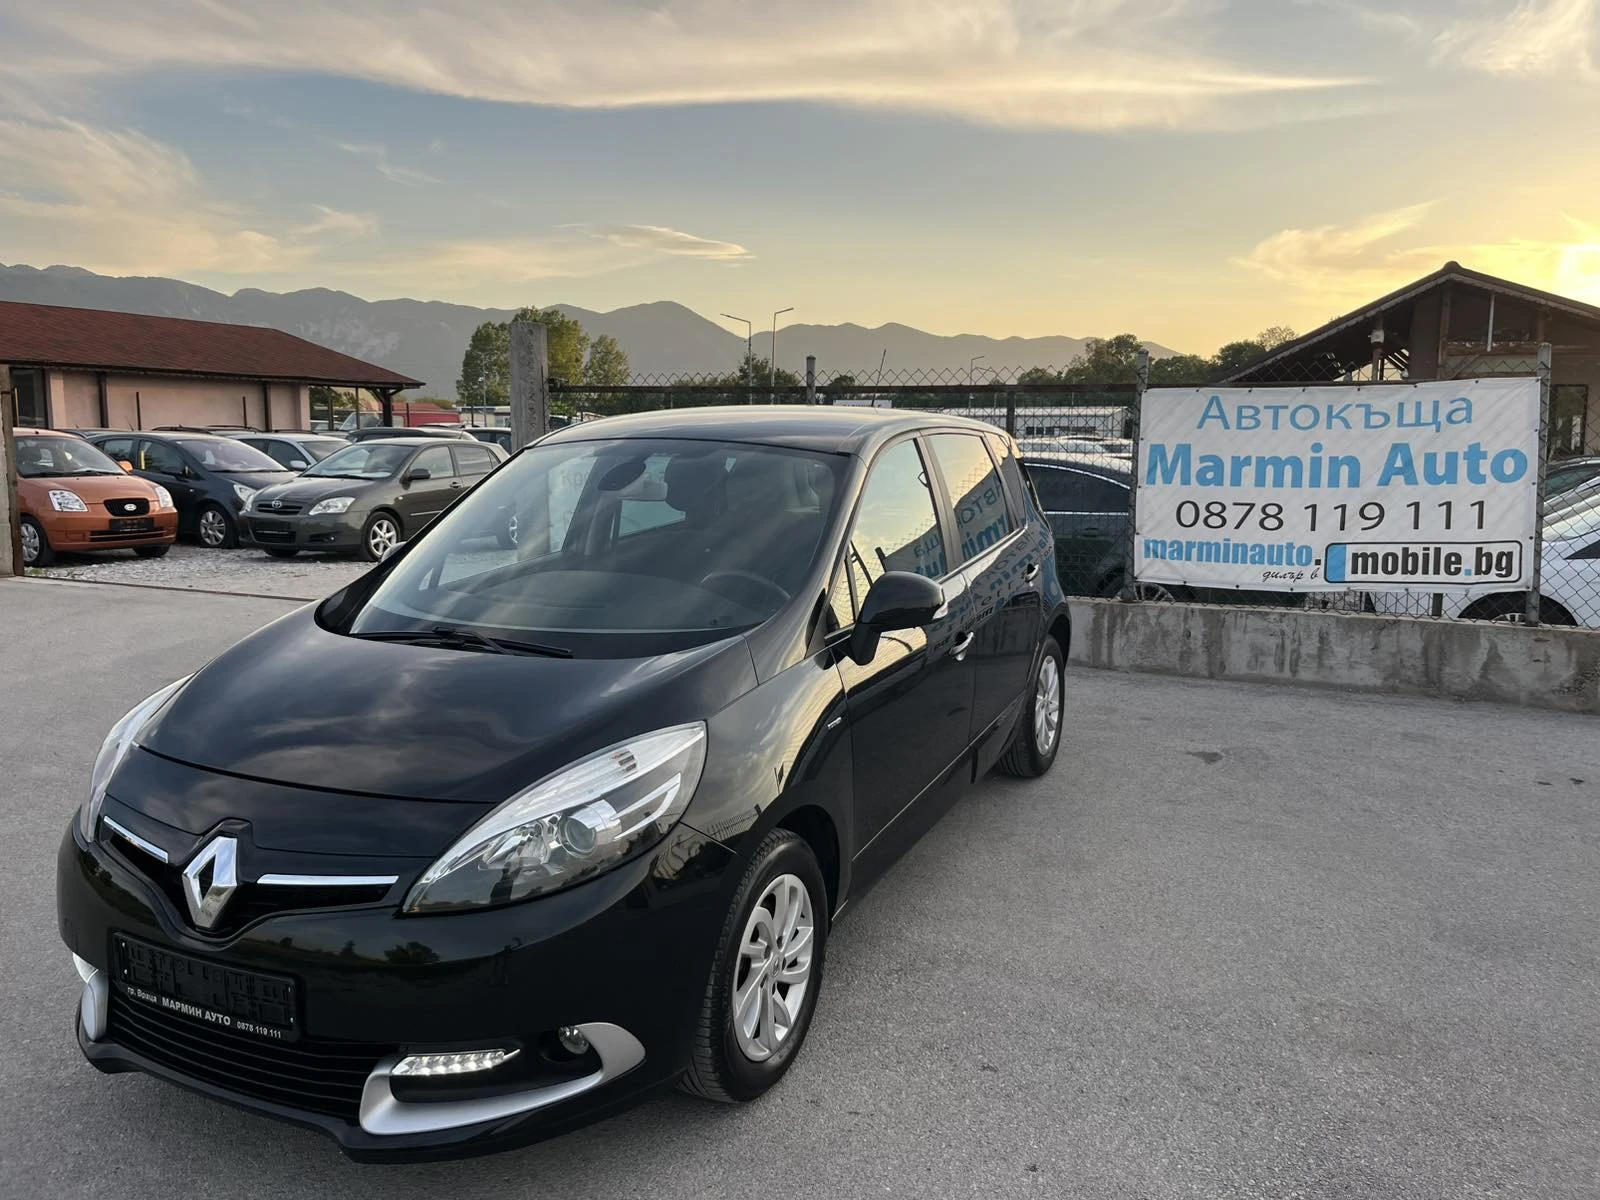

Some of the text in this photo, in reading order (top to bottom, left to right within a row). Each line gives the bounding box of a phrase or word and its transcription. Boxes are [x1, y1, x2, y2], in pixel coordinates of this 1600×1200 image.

[1196, 395, 1473, 433] Автокъща
[1145, 441, 1528, 489] Marmin Auto
[1175, 499, 1486, 532] 0878 119 111
[1350, 546, 1514, 578] mobile.bg
[162, 997, 202, 1018] МАРМИН
[204, 1010, 231, 1025] АУТО
[236, 1021, 254, 1032] 0878
[255, 1026, 268, 1036] 119
[269, 1029, 281, 1039] 111
